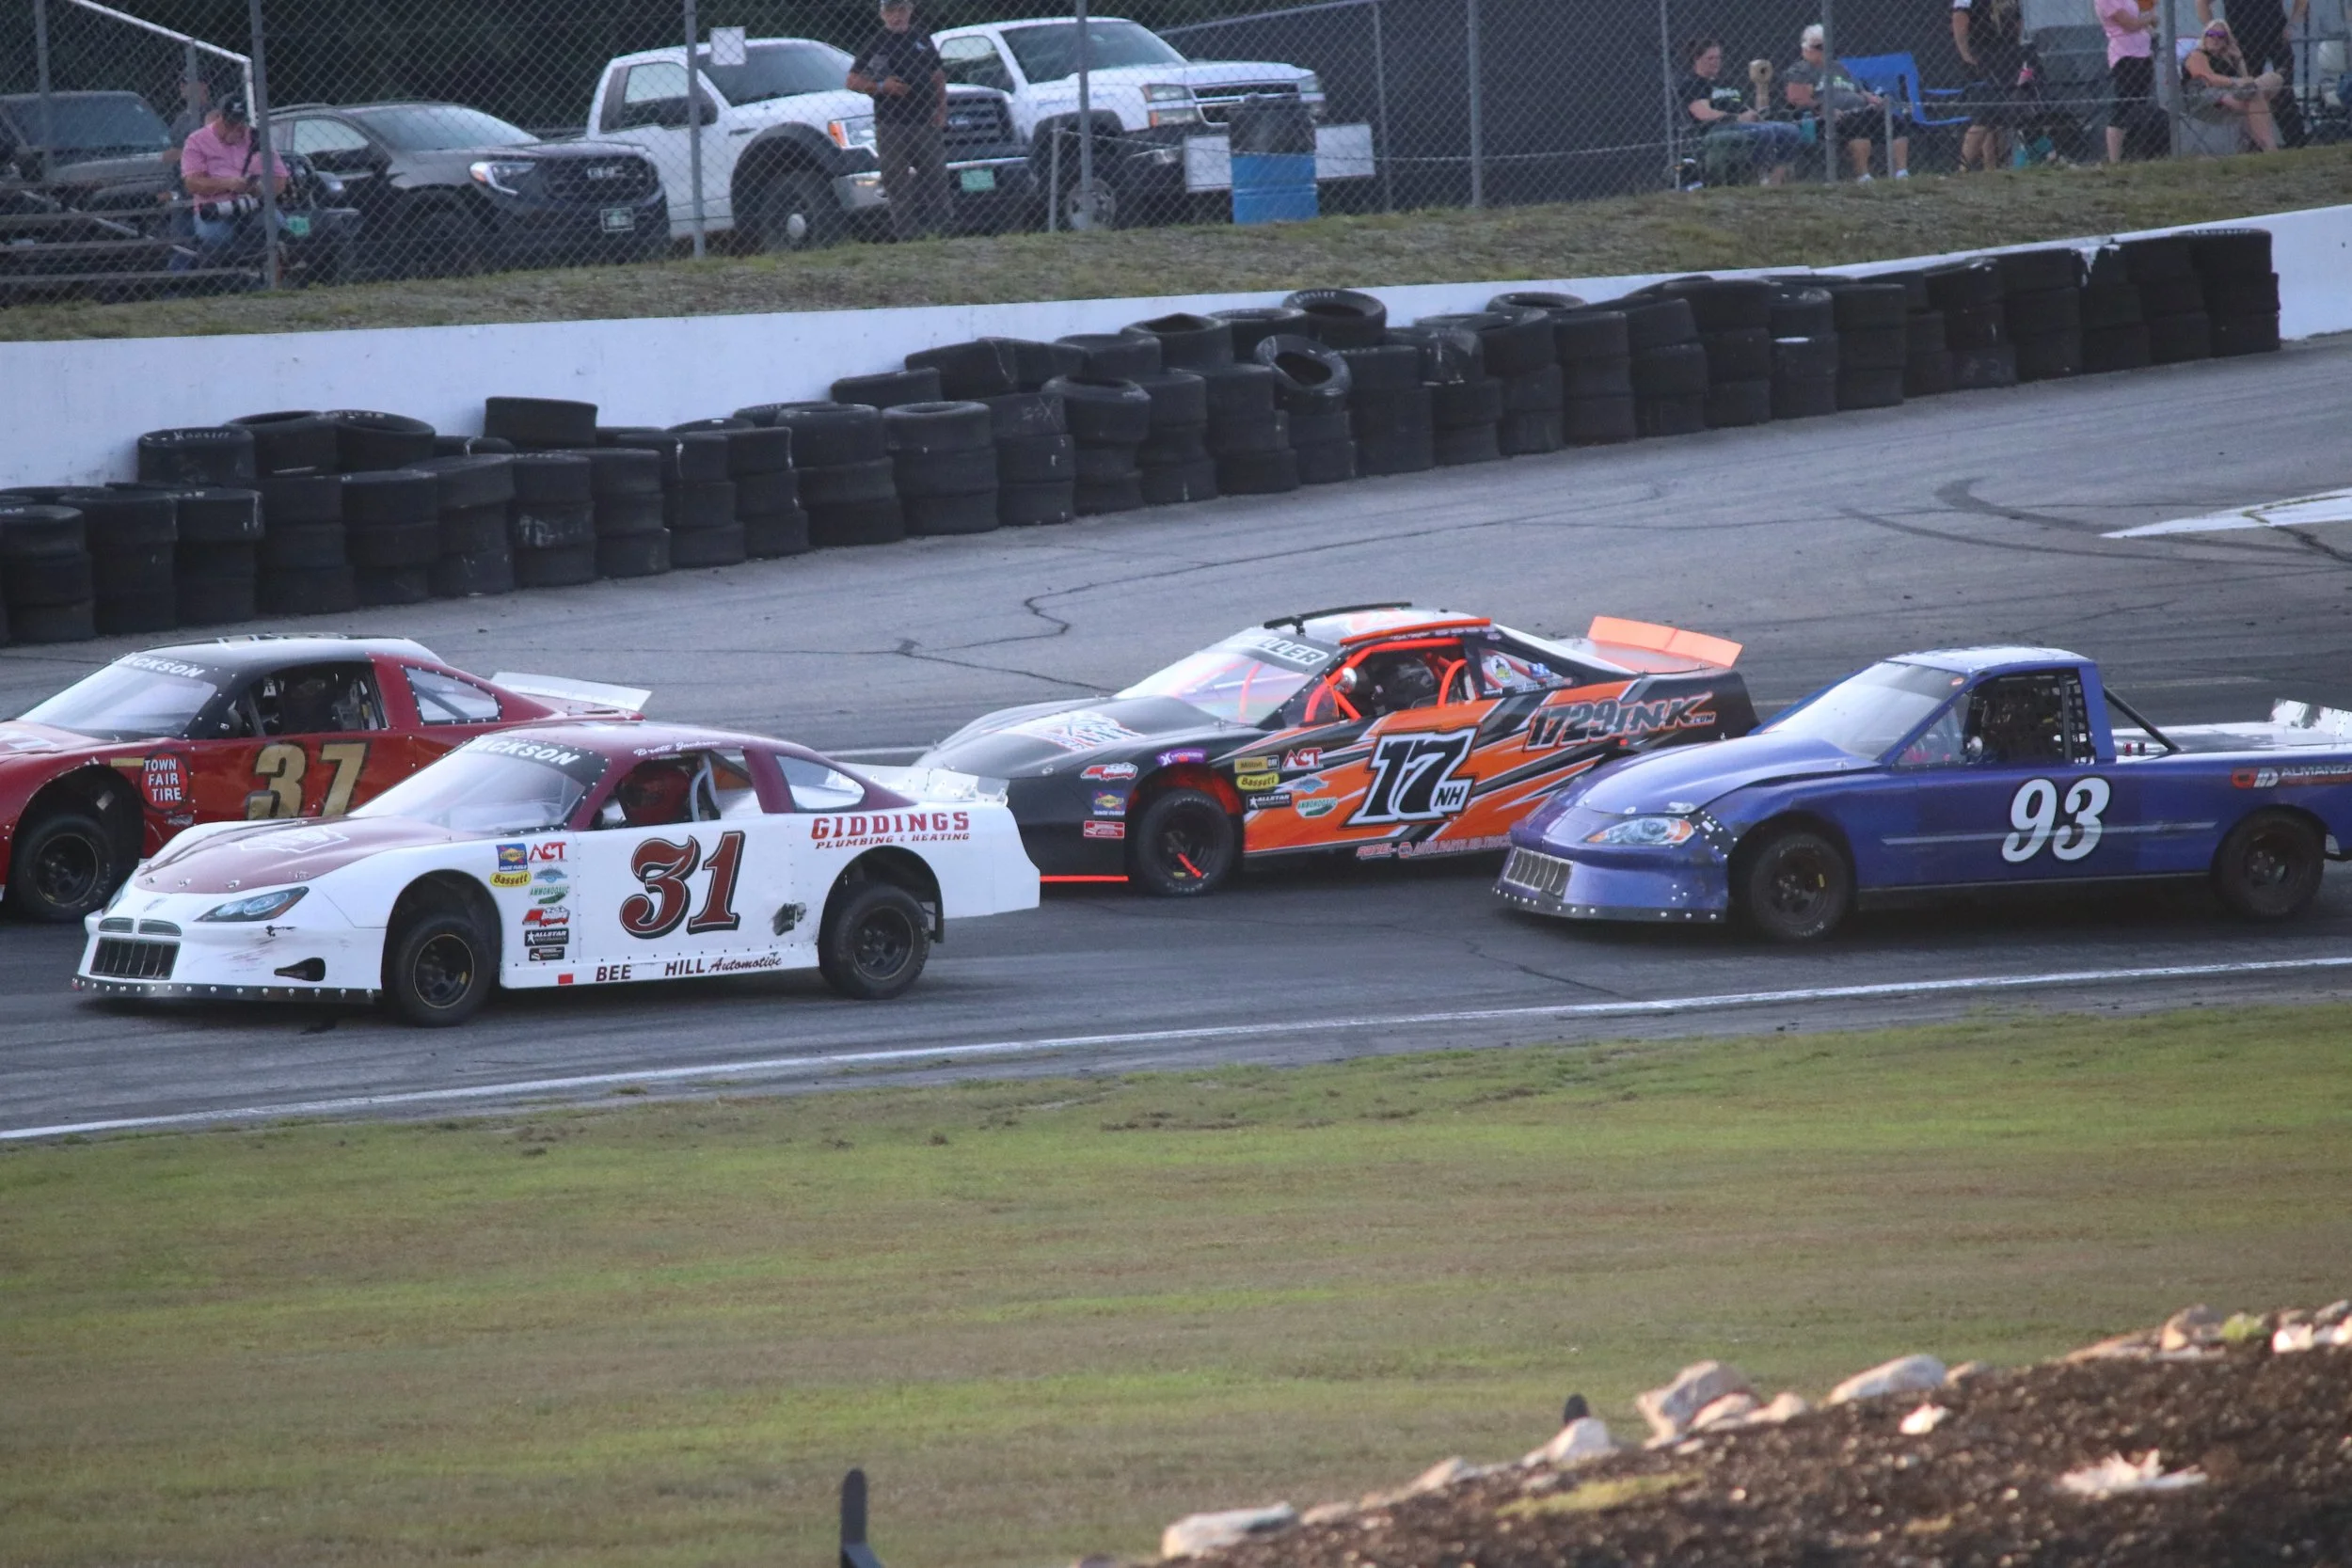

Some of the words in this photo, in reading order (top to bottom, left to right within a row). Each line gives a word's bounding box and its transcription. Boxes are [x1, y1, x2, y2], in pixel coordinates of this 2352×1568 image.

[144, 759, 177, 771] TOWN
[1282, 748, 1323, 768] ACT
[149, 772, 179, 786] FAIR
[246, 742, 368, 821] 37
[1347, 726, 1478, 825] 17
[1434, 786, 1465, 807] NH
[152, 787, 183, 801] TIRE
[811, 812, 970, 840] GIDDINGS
[2001, 777, 2110, 863] 93
[816, 835, 894, 849] PLUMBING
[912, 832, 970, 843] HEATING
[529, 842, 566, 861] ACT
[494, 874, 529, 884] Bassett
[620, 831, 746, 939] 31
[596, 964, 631, 982] BEE
[665, 958, 706, 976] HILL
[709, 952, 782, 974] Automotive
